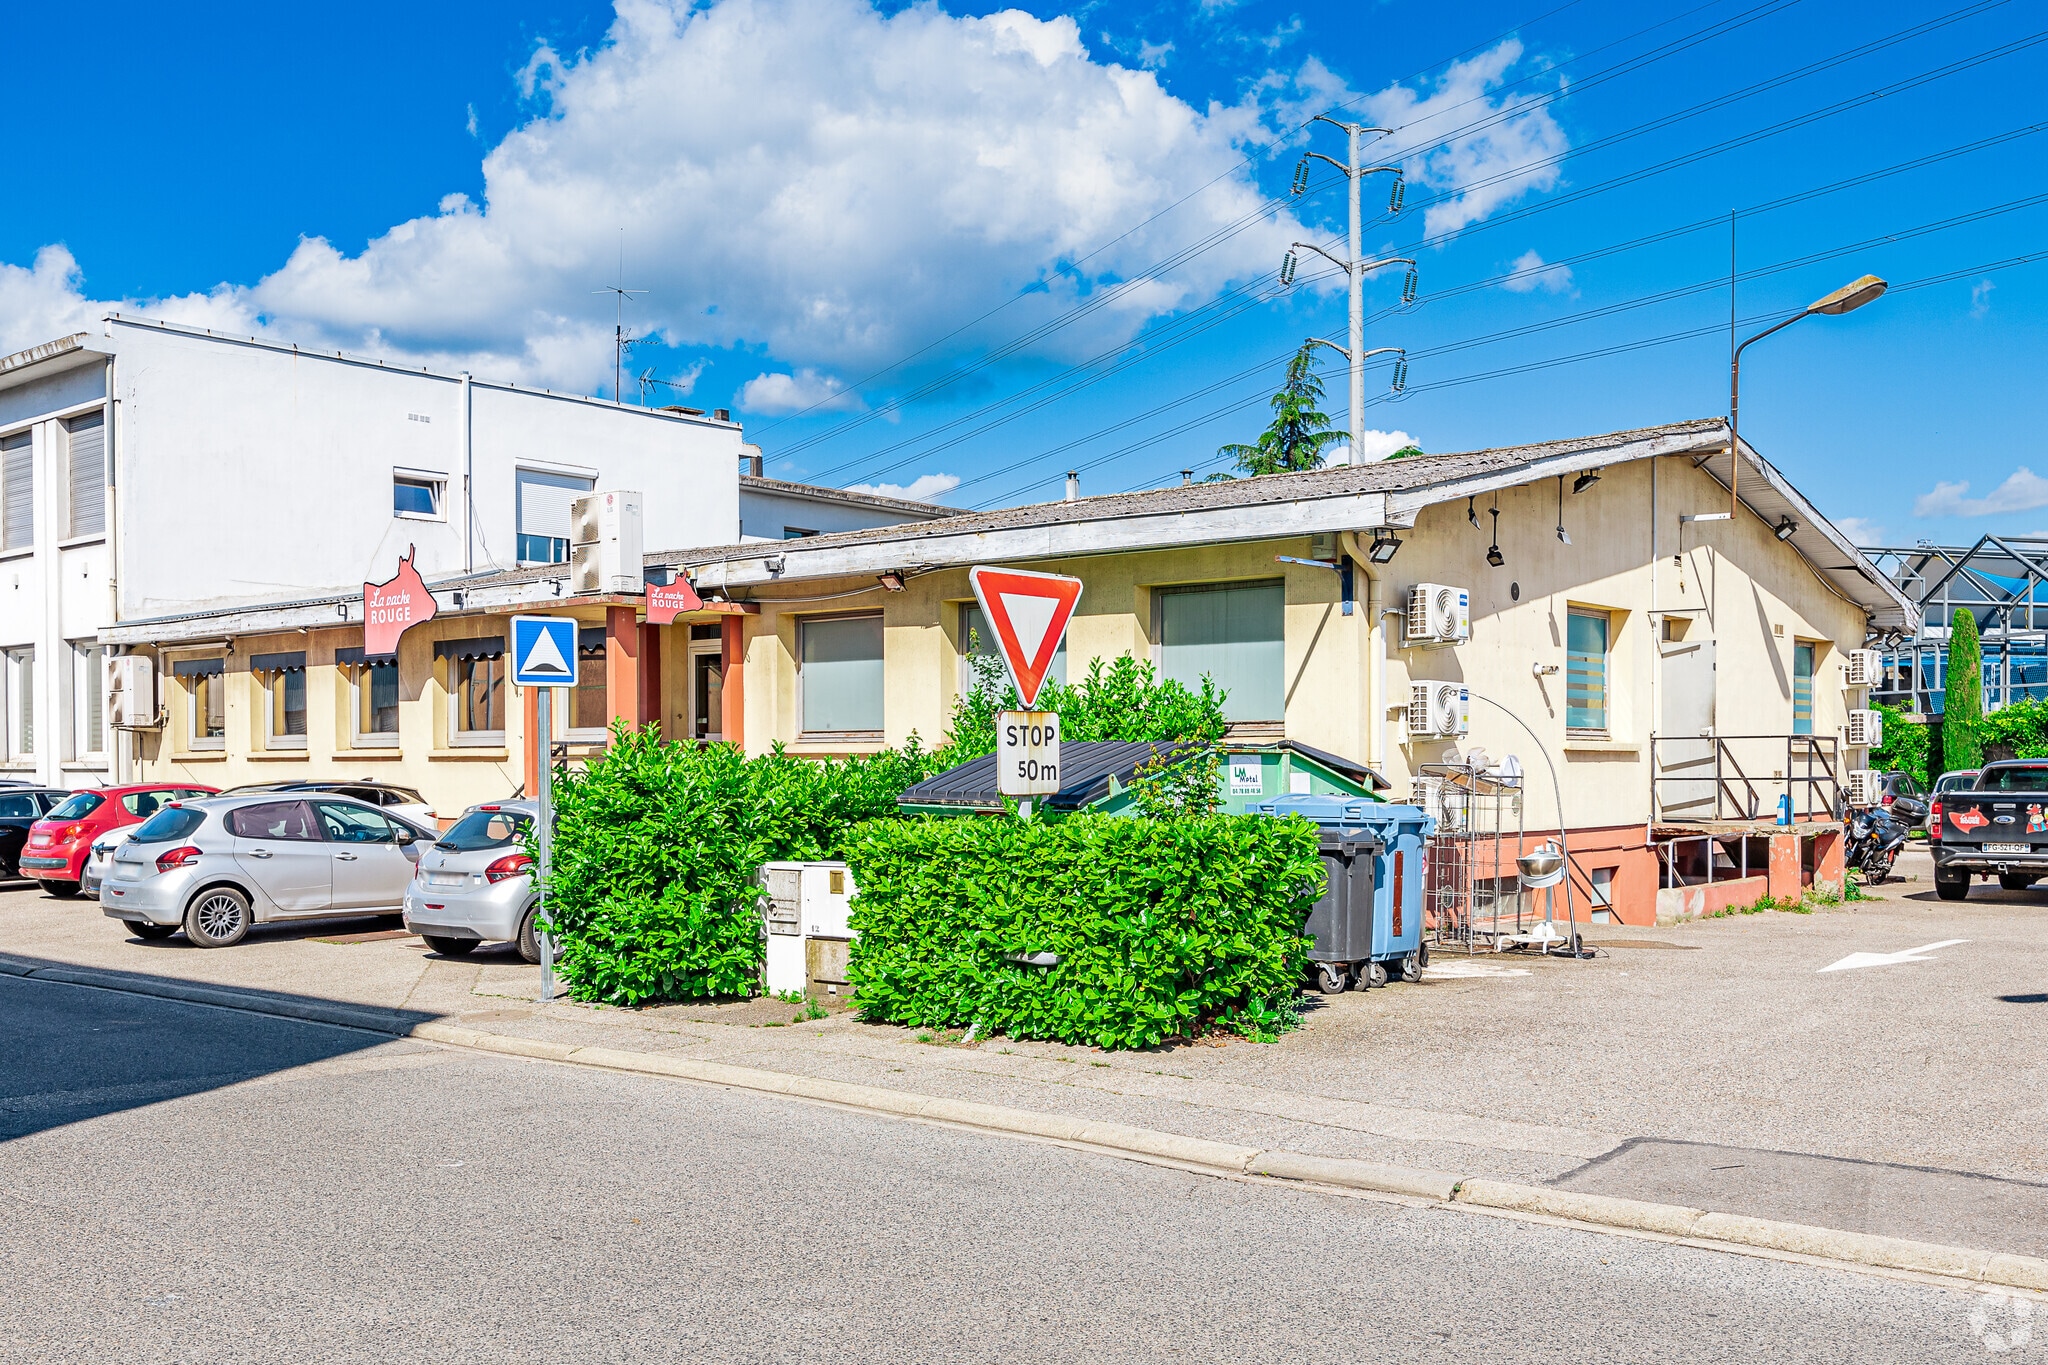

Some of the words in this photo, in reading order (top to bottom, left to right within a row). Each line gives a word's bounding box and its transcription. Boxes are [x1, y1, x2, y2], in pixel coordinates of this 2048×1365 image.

[370, 588, 384, 608] La
[386, 589, 411, 605] vache
[651, 587, 663, 599] La
[665, 591, 684, 600] vache
[652, 599, 684, 609] ROUGE
[371, 606, 411, 624] ROUGE
[1006, 725, 1055, 747] STOP
[1234, 766, 1247, 778] LM
